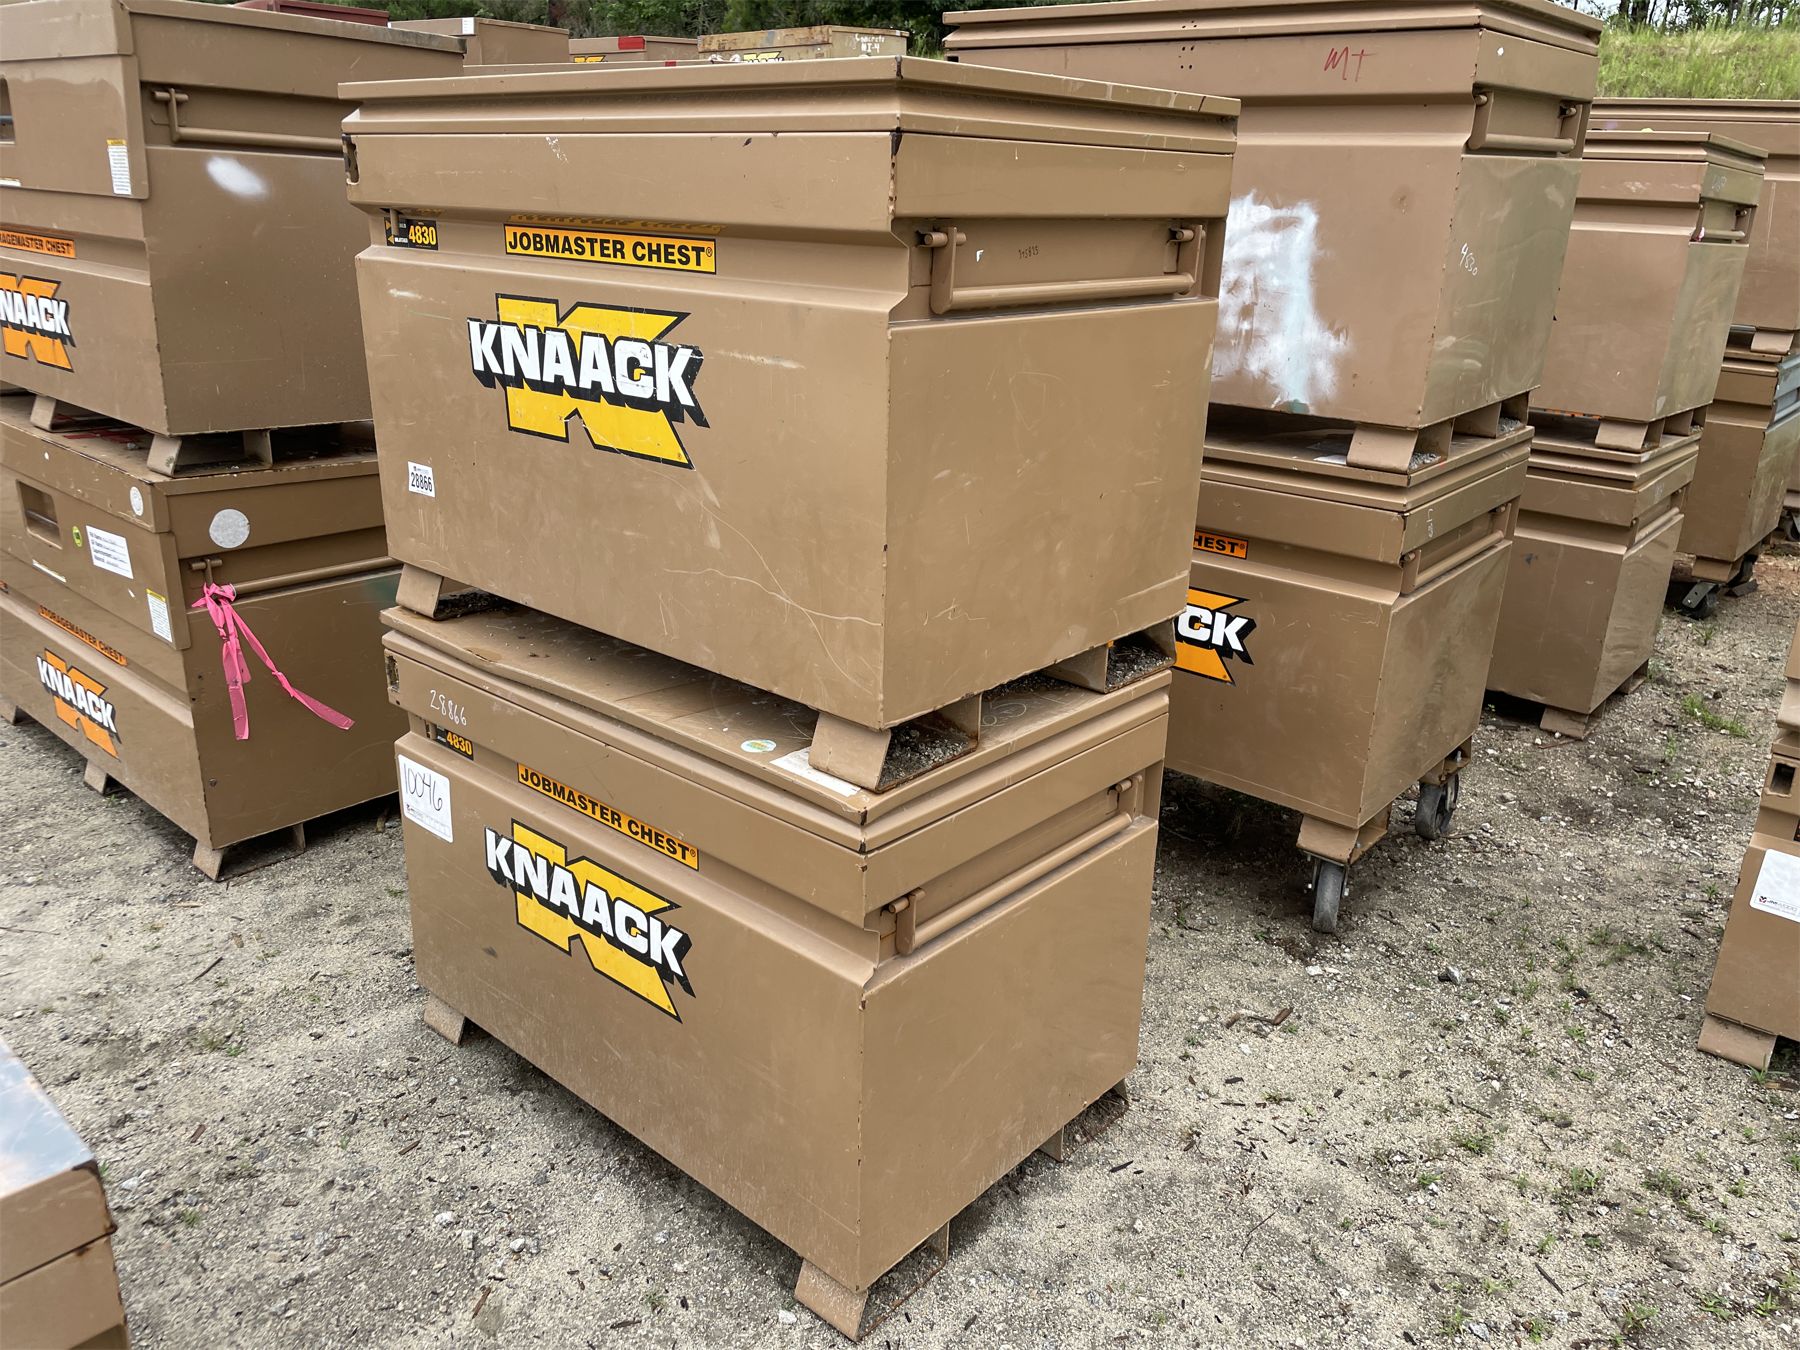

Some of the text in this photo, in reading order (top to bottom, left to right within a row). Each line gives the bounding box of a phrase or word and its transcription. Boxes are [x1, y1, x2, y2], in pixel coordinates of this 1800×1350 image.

[408, 225, 437, 245] 4830
[508, 231, 626, 259] JOBMASTER
[468, 317, 704, 414] KNAACK
[411, 471, 433, 492] 28866
[36, 655, 119, 738] KNAACK
[430, 689, 467, 726] 28866
[446, 731, 473, 755] 4830
[403, 763, 443, 811] 10046
[520, 768, 623, 829] JOBMASTER
[484, 826, 690, 984] KNAACK
